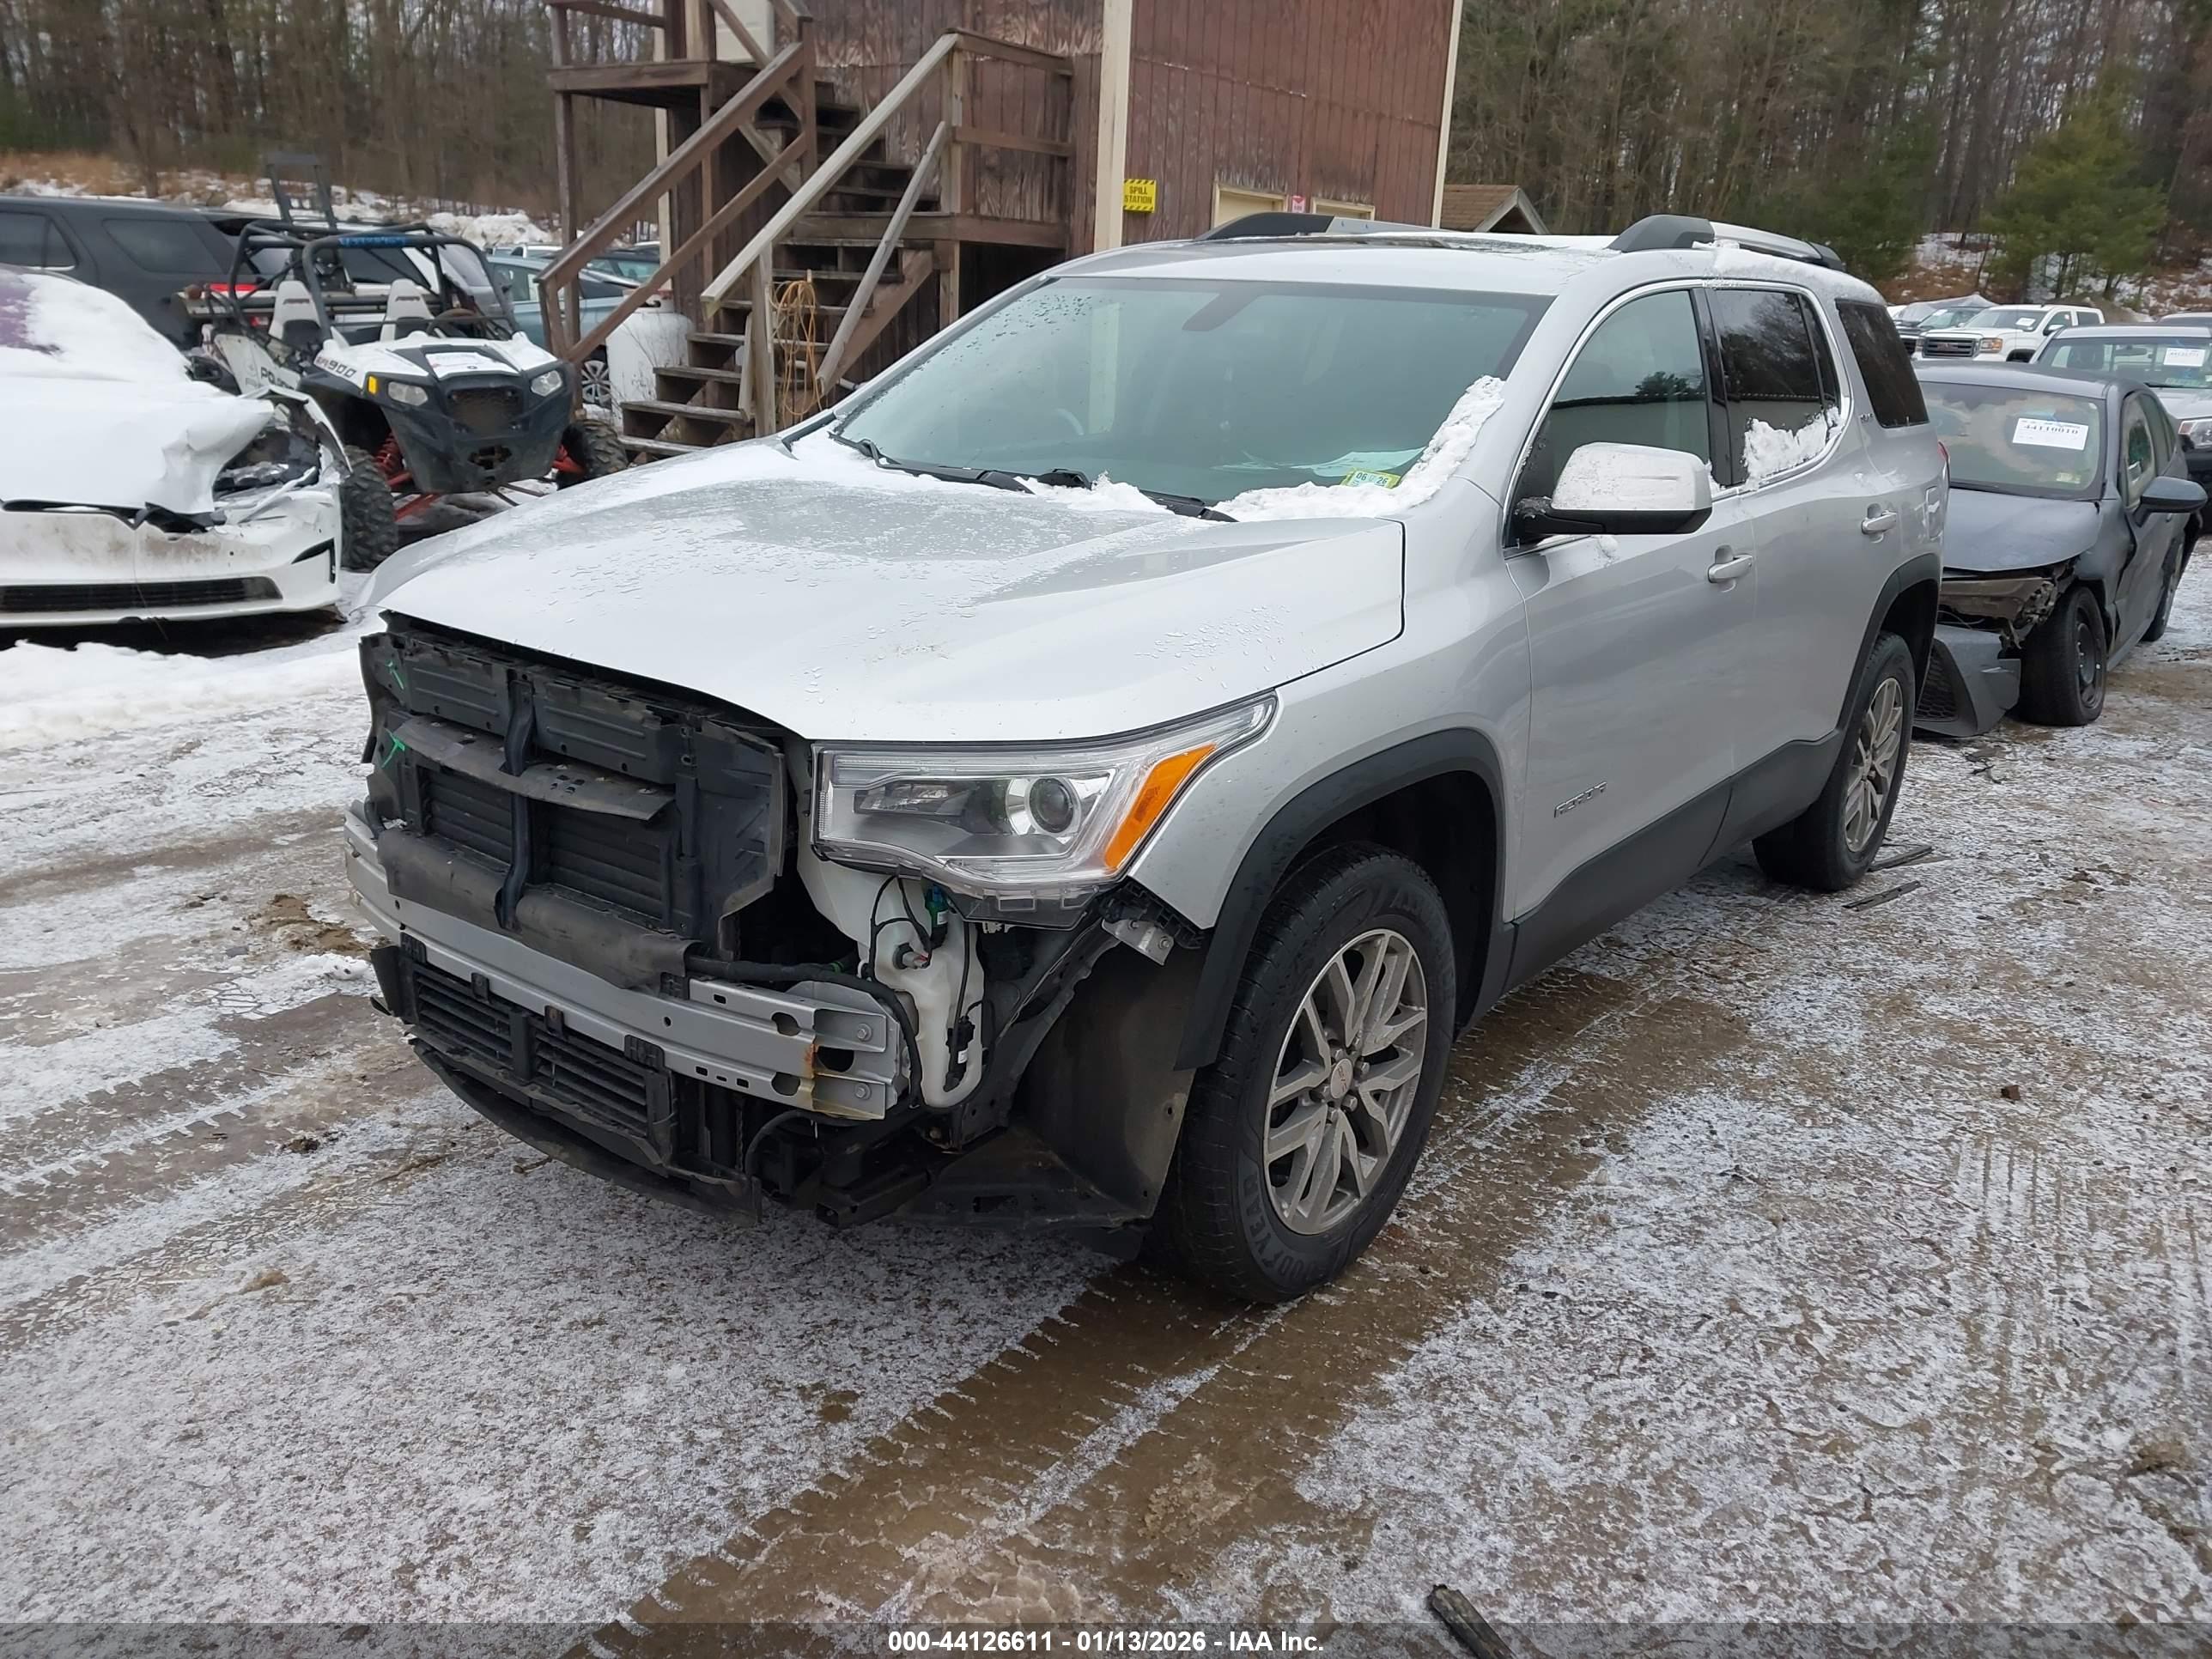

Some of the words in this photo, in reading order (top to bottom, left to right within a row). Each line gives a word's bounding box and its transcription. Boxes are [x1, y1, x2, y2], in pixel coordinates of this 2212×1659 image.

[1129, 185, 1147, 195] SPILL
[1124, 195, 1152, 204] STATION
[325, 360, 357, 379] 900
[1356, 471, 1368, 482] 06
[1376, 476, 1389, 485] 26
